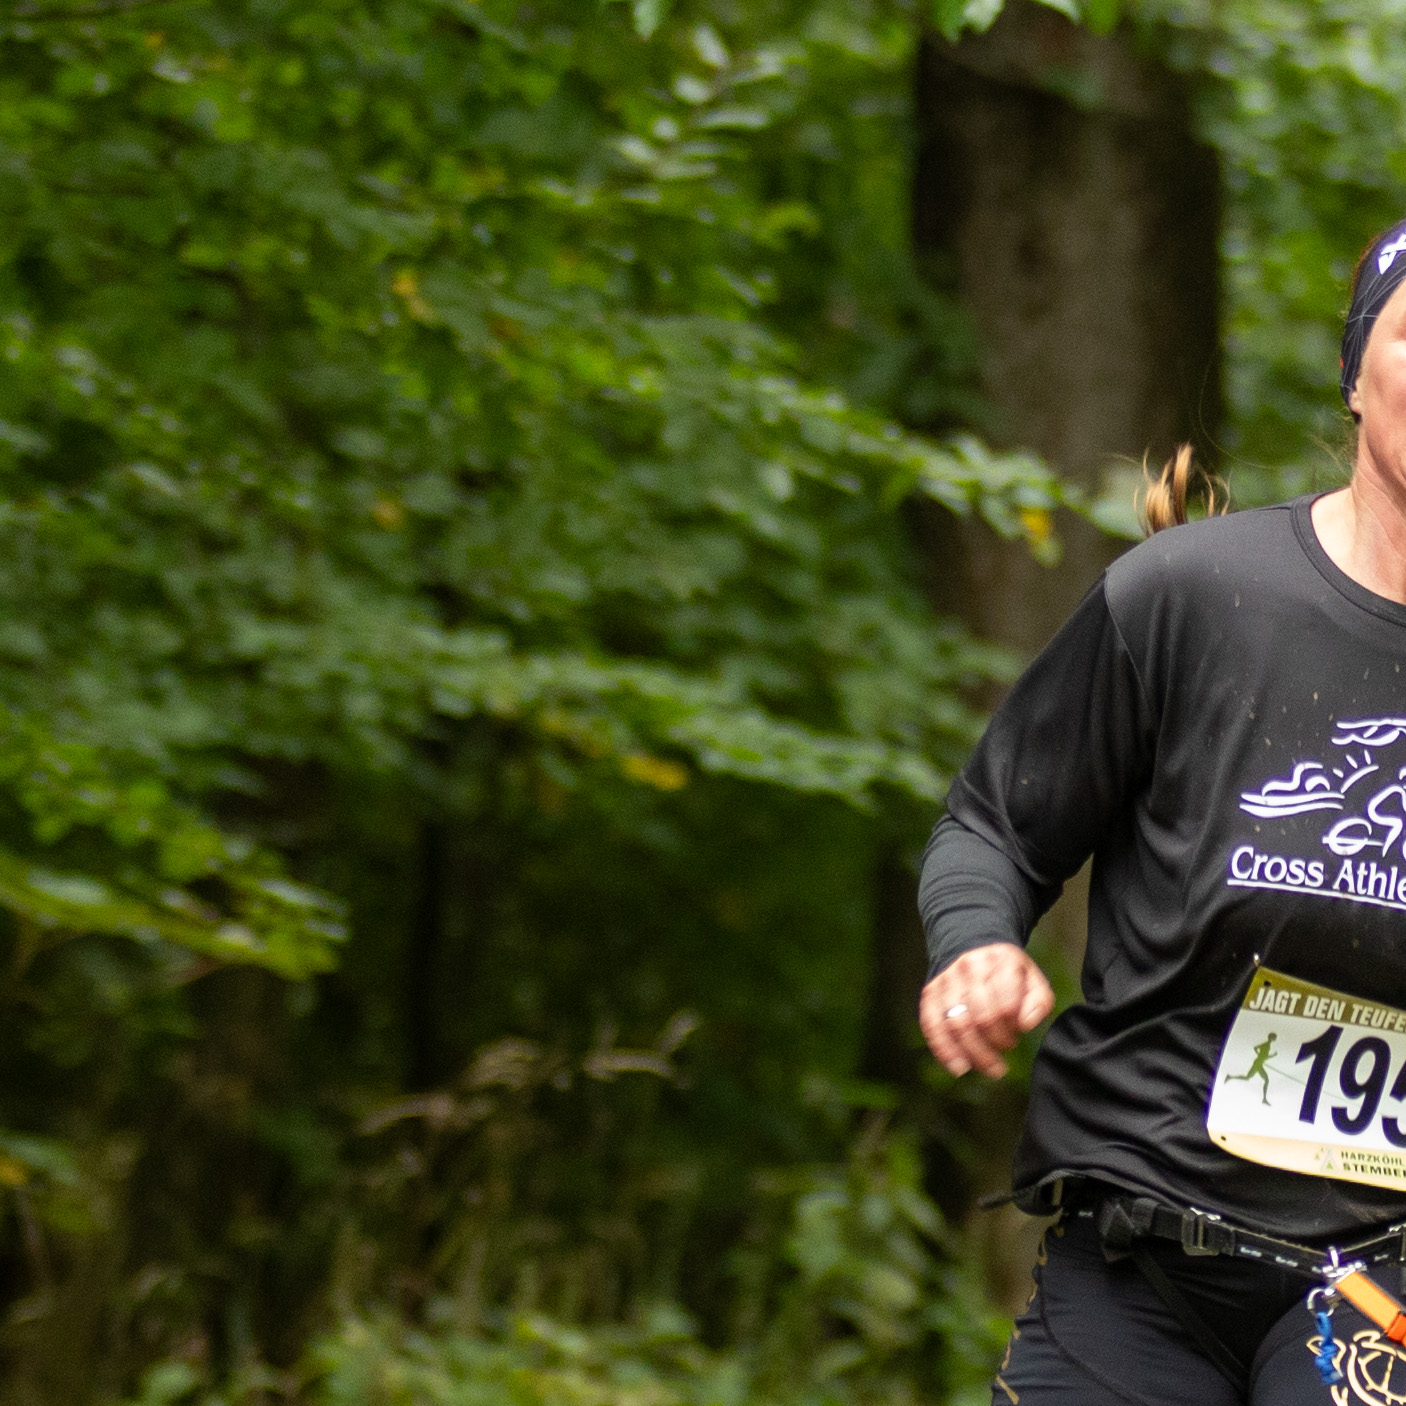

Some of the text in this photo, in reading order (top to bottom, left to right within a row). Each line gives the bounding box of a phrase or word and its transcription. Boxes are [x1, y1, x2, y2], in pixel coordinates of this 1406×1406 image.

[1231, 846, 1325, 887] Cross
[1249, 987, 1302, 1015] JAGT
[1303, 995, 1346, 1021] DEN
